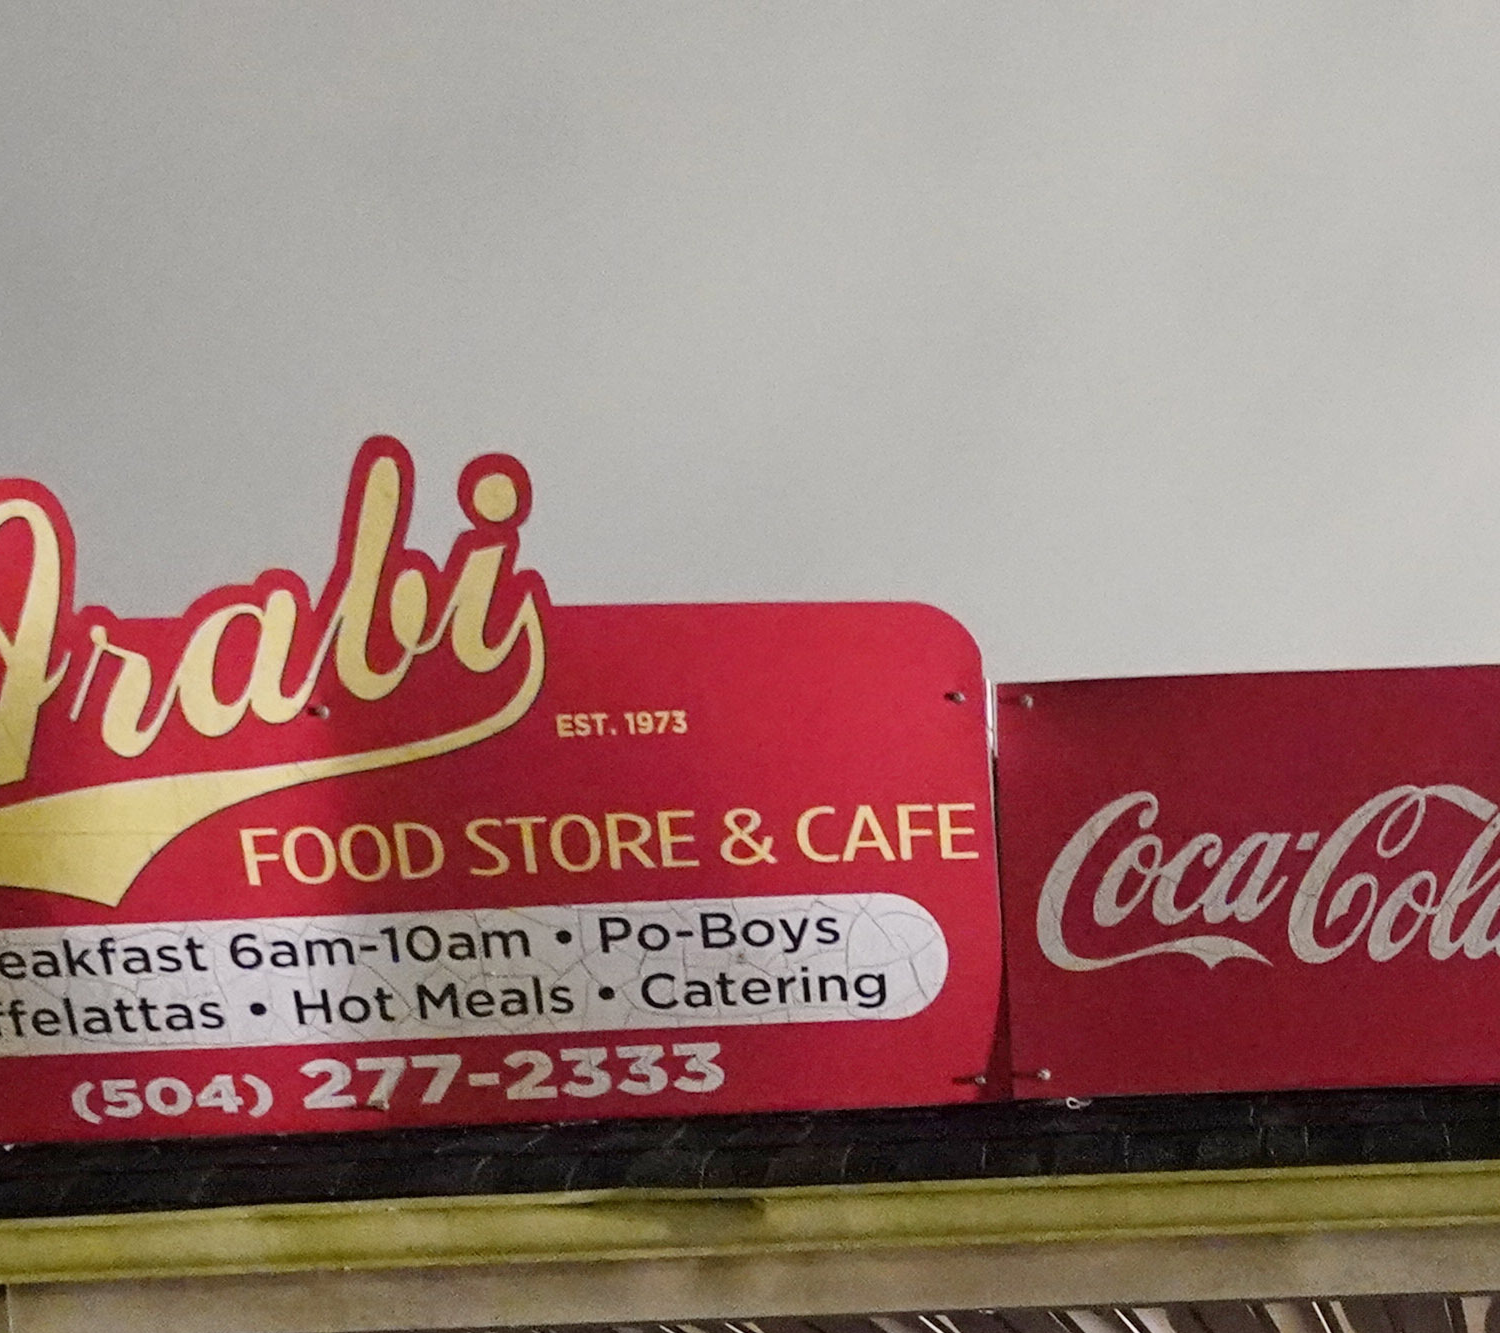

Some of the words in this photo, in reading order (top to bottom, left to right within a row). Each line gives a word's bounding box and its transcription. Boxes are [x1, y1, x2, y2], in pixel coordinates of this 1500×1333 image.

[556, 711, 616, 738] EST.
[624, 708, 689, 737] 1973
[239, 822, 445, 887] FOOD
[464, 810, 700, 877] STORE
[720, 807, 778, 867] &
[796, 802, 980, 863] CAFE
[229, 923, 531, 971] 6am-10am
[599, 911, 840, 954] Po-Boys
[293, 988, 396, 1026] Hot
[417, 976, 575, 1020] Meals
[641, 966, 888, 1010] Catering
[71, 1072, 273, 1125] (504)
[299, 1041, 726, 1111] 277-2333
